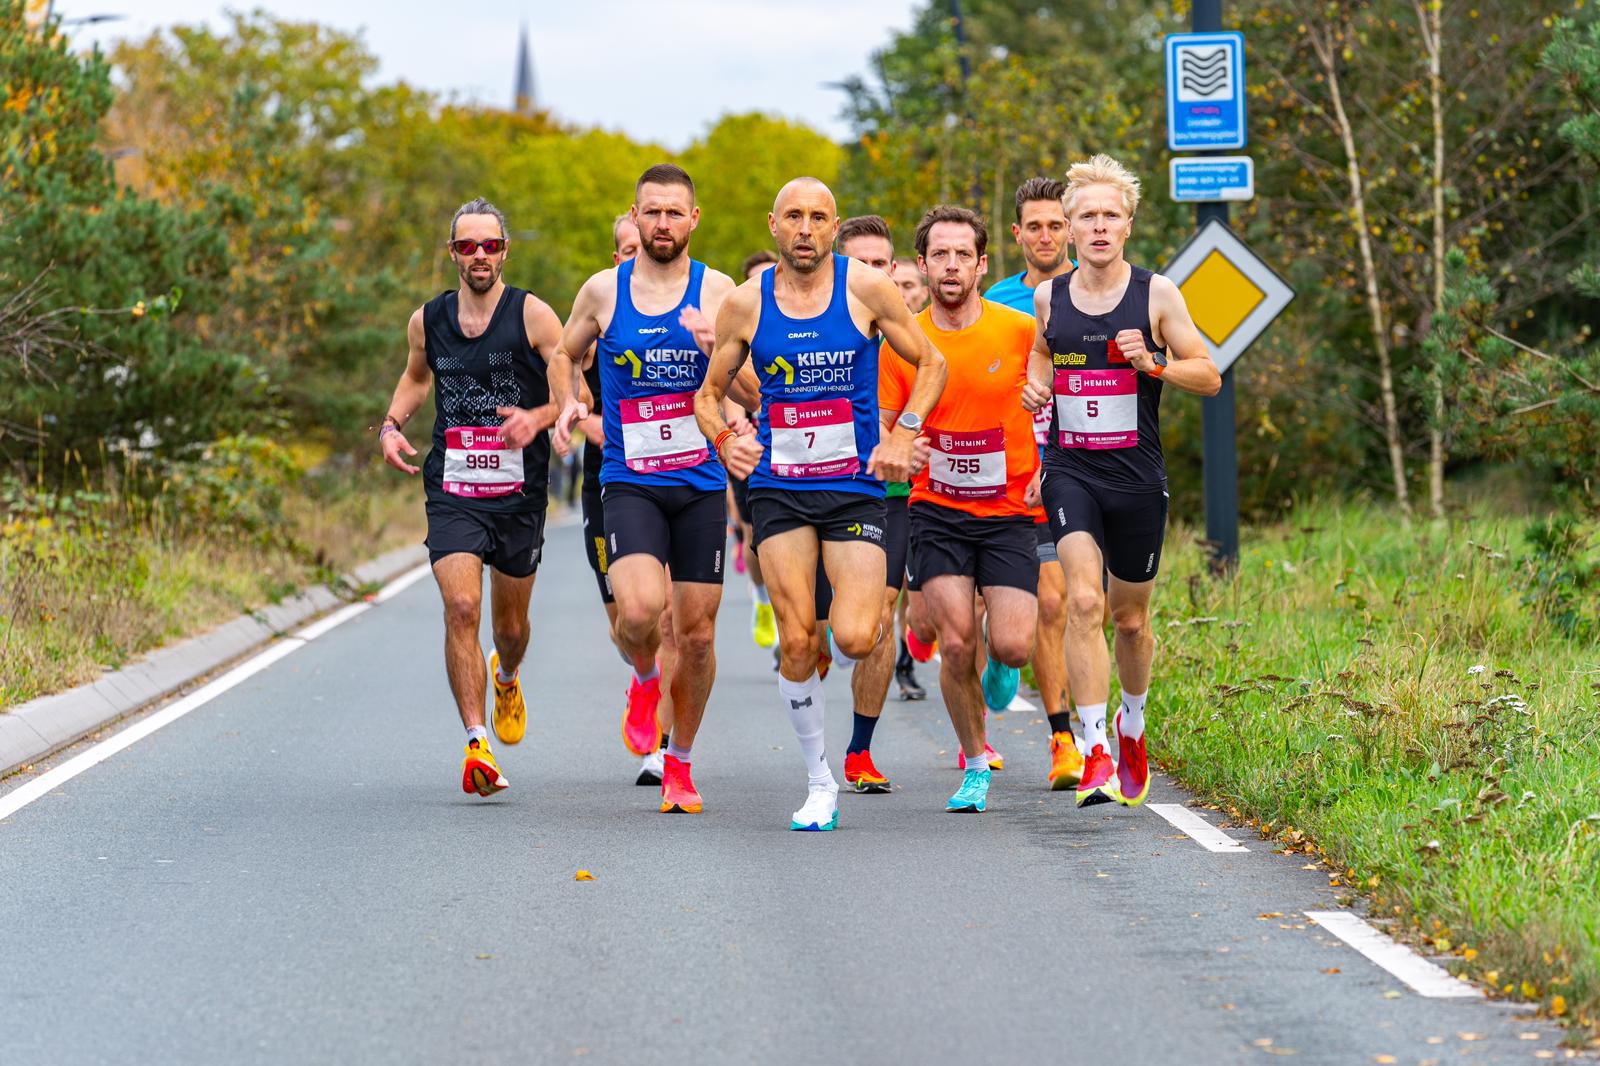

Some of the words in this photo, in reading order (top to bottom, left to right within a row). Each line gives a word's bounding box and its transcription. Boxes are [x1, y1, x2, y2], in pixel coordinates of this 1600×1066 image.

[645, 349, 698, 362] KIEVIT
[797, 350, 856, 367] KIEVIT
[646, 364, 698, 379] SPORT
[800, 366, 854, 384] SPORT
[784, 385, 827, 394] RUNNINGTEAM
[827, 383, 855, 392] HENGELO
[655, 402, 686, 411] HEMINK
[799, 409, 832, 418] HEMINK
[1087, 400, 1099, 418] 5
[660, 424, 672, 441] 6
[804, 431, 816, 449] 7
[466, 454, 499, 469] 999
[947, 458, 980, 473] 755
[862, 531, 882, 541] SPORT
[863, 524, 883, 535] KIEVIT
